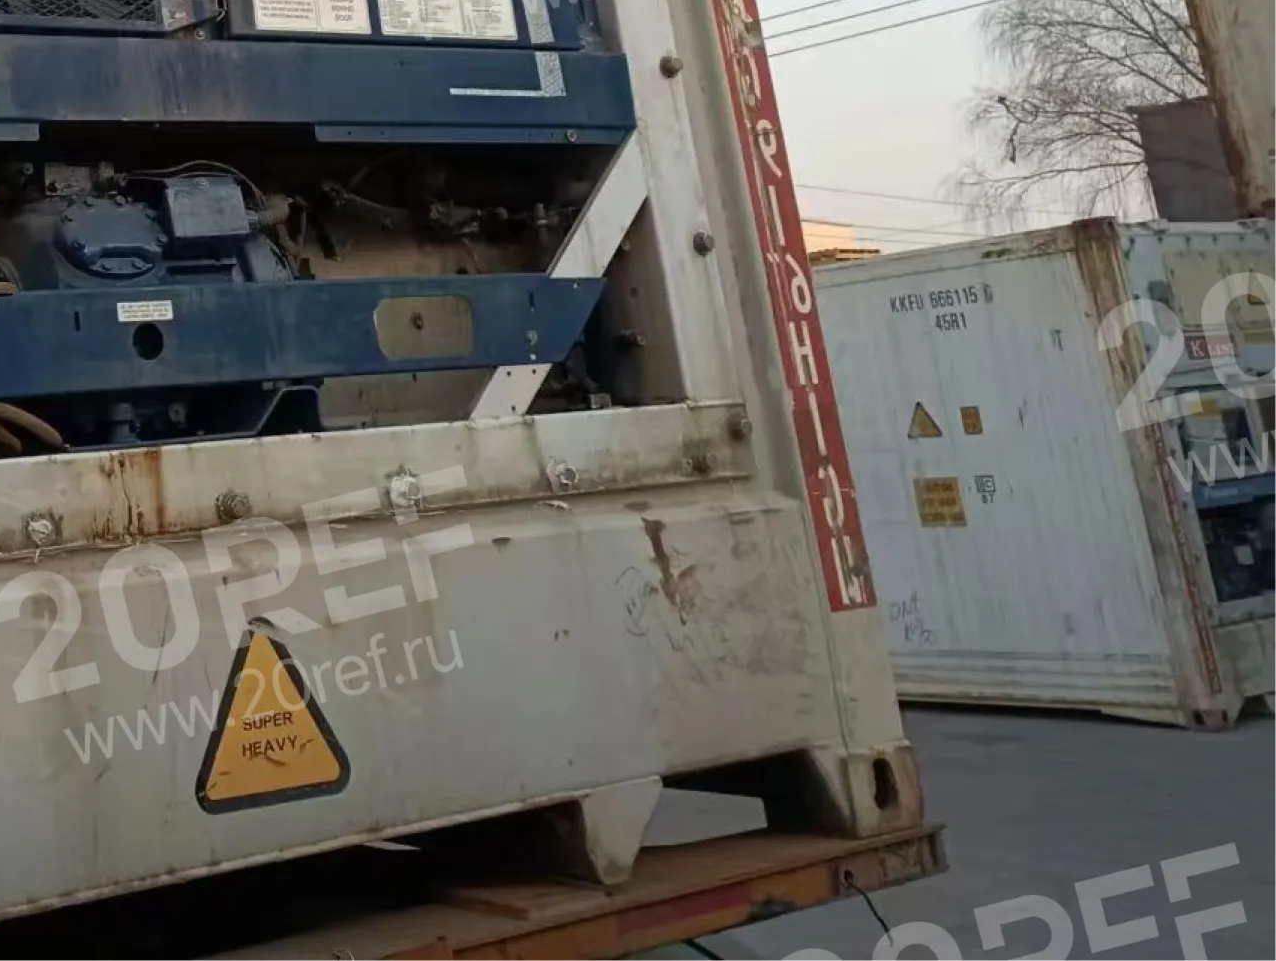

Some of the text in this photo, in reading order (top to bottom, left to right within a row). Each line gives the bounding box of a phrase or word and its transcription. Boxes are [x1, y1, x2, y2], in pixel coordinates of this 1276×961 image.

[929, 286, 978, 310] 666115
[242, 711, 294, 733] SUPER
[242, 735, 299, 759] HEAVY
